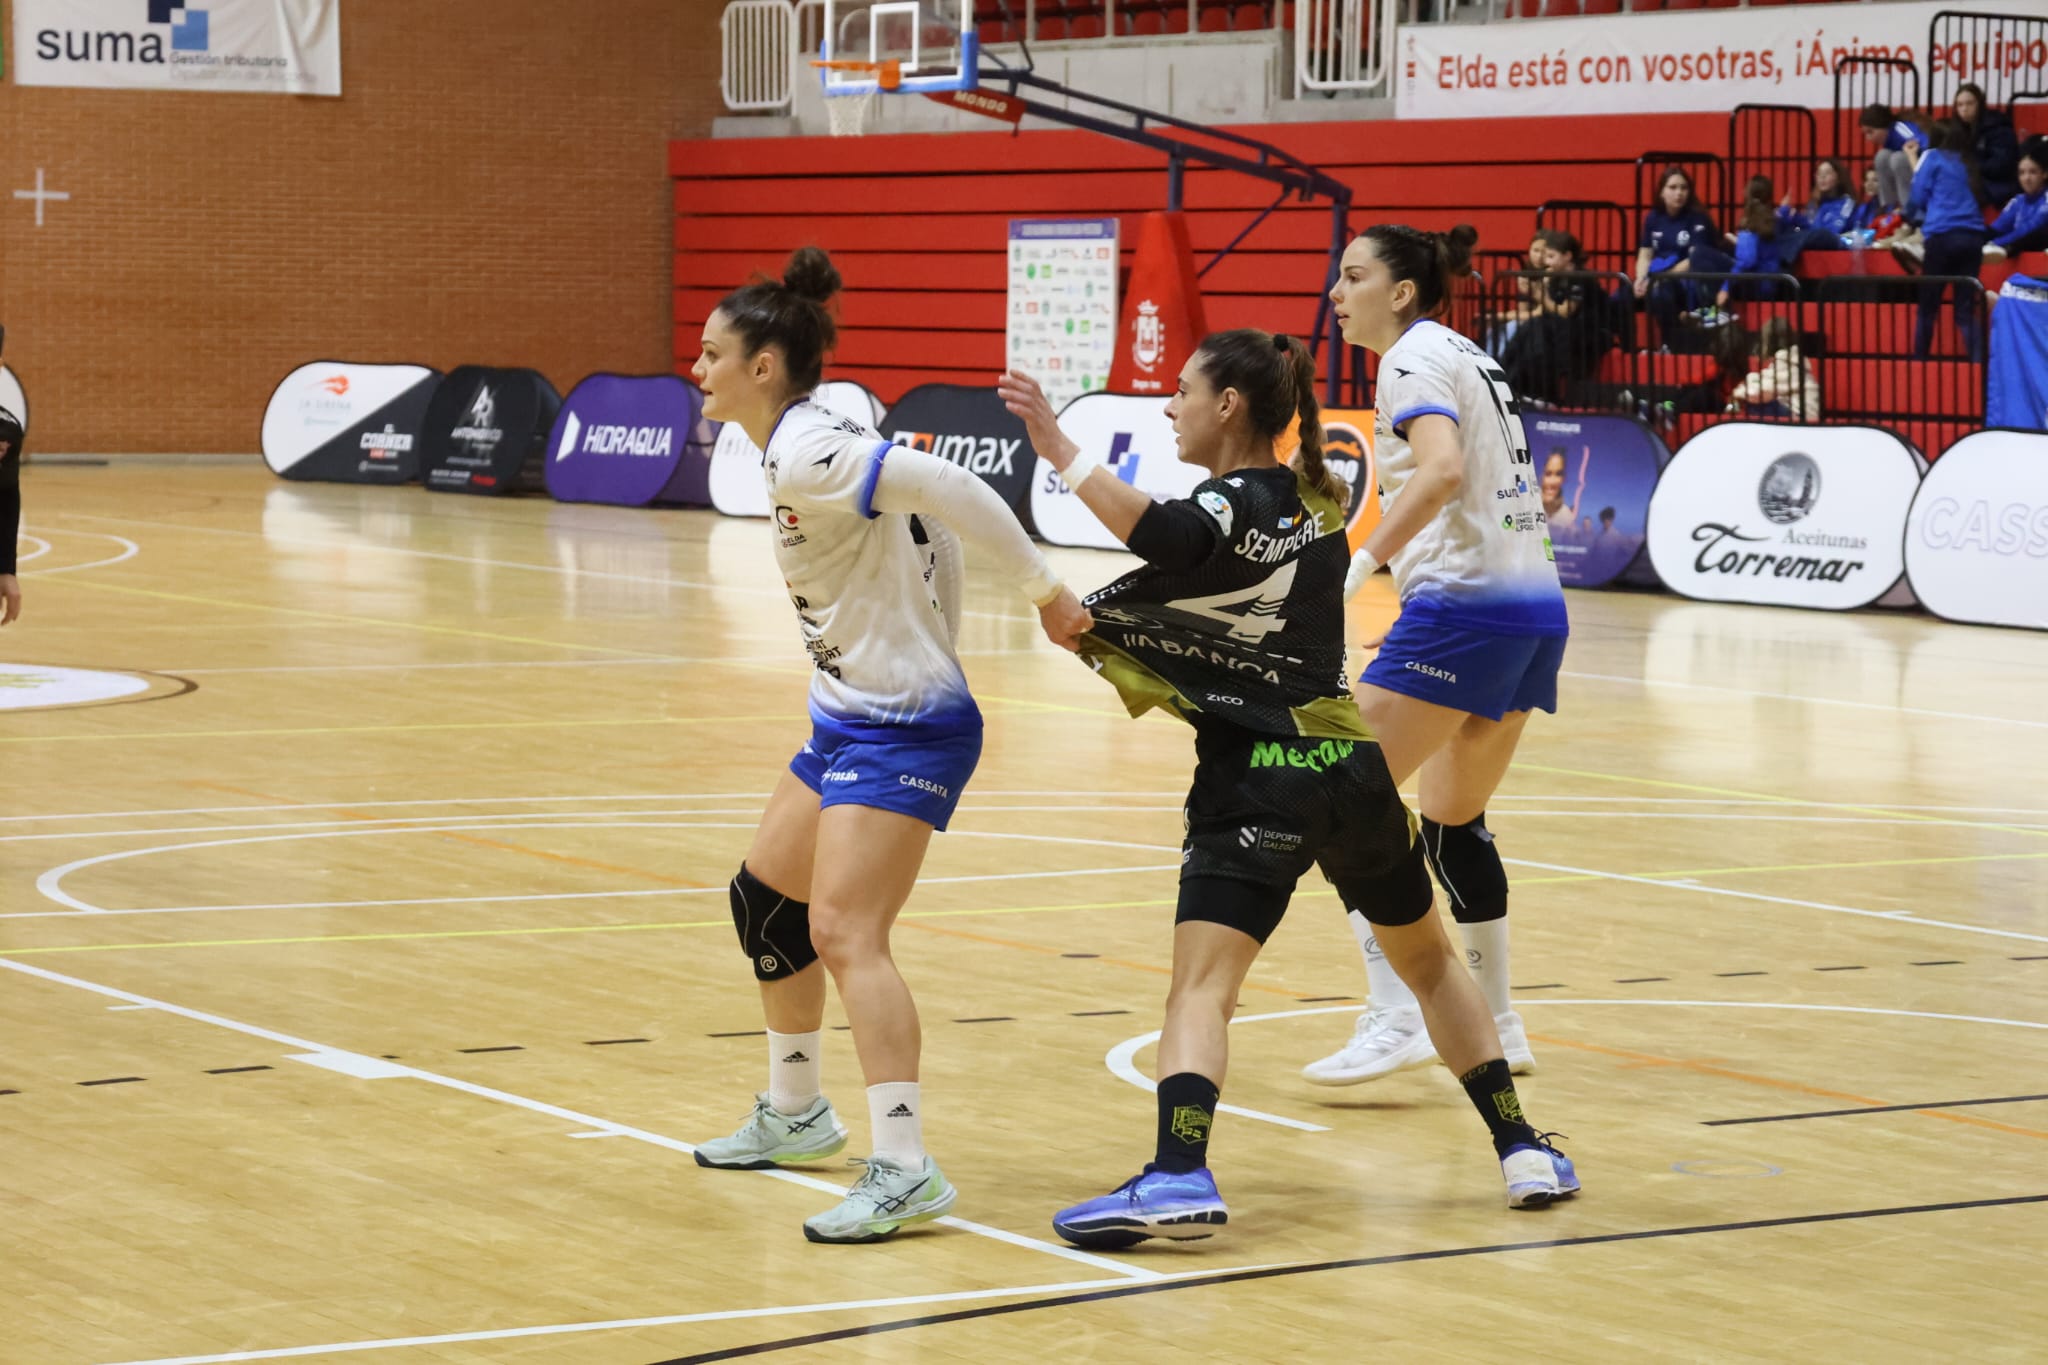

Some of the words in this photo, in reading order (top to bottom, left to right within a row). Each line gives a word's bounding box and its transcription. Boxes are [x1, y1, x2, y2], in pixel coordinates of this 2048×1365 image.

[36, 29, 165, 64] suma
[1438, 54, 1498, 89] Elda
[1508, 48, 1568, 87] está
[1578, 56, 1631, 84] con
[1643, 46, 1783, 84] vosotras,
[953, 91, 1007, 113] MONDO
[1235, 511, 1325, 563] SEMPERE
[1782, 527, 1867, 550] Aceitunas
[1691, 522, 1864, 583] Torremar
[1164, 559, 1297, 645] 4
[1405, 661, 1456, 684] CASSATA
[899, 774, 948, 798] CASSATA
[1262, 841, 1296, 852] GALEGO
[1264, 830, 1303, 843] DEPORTE
